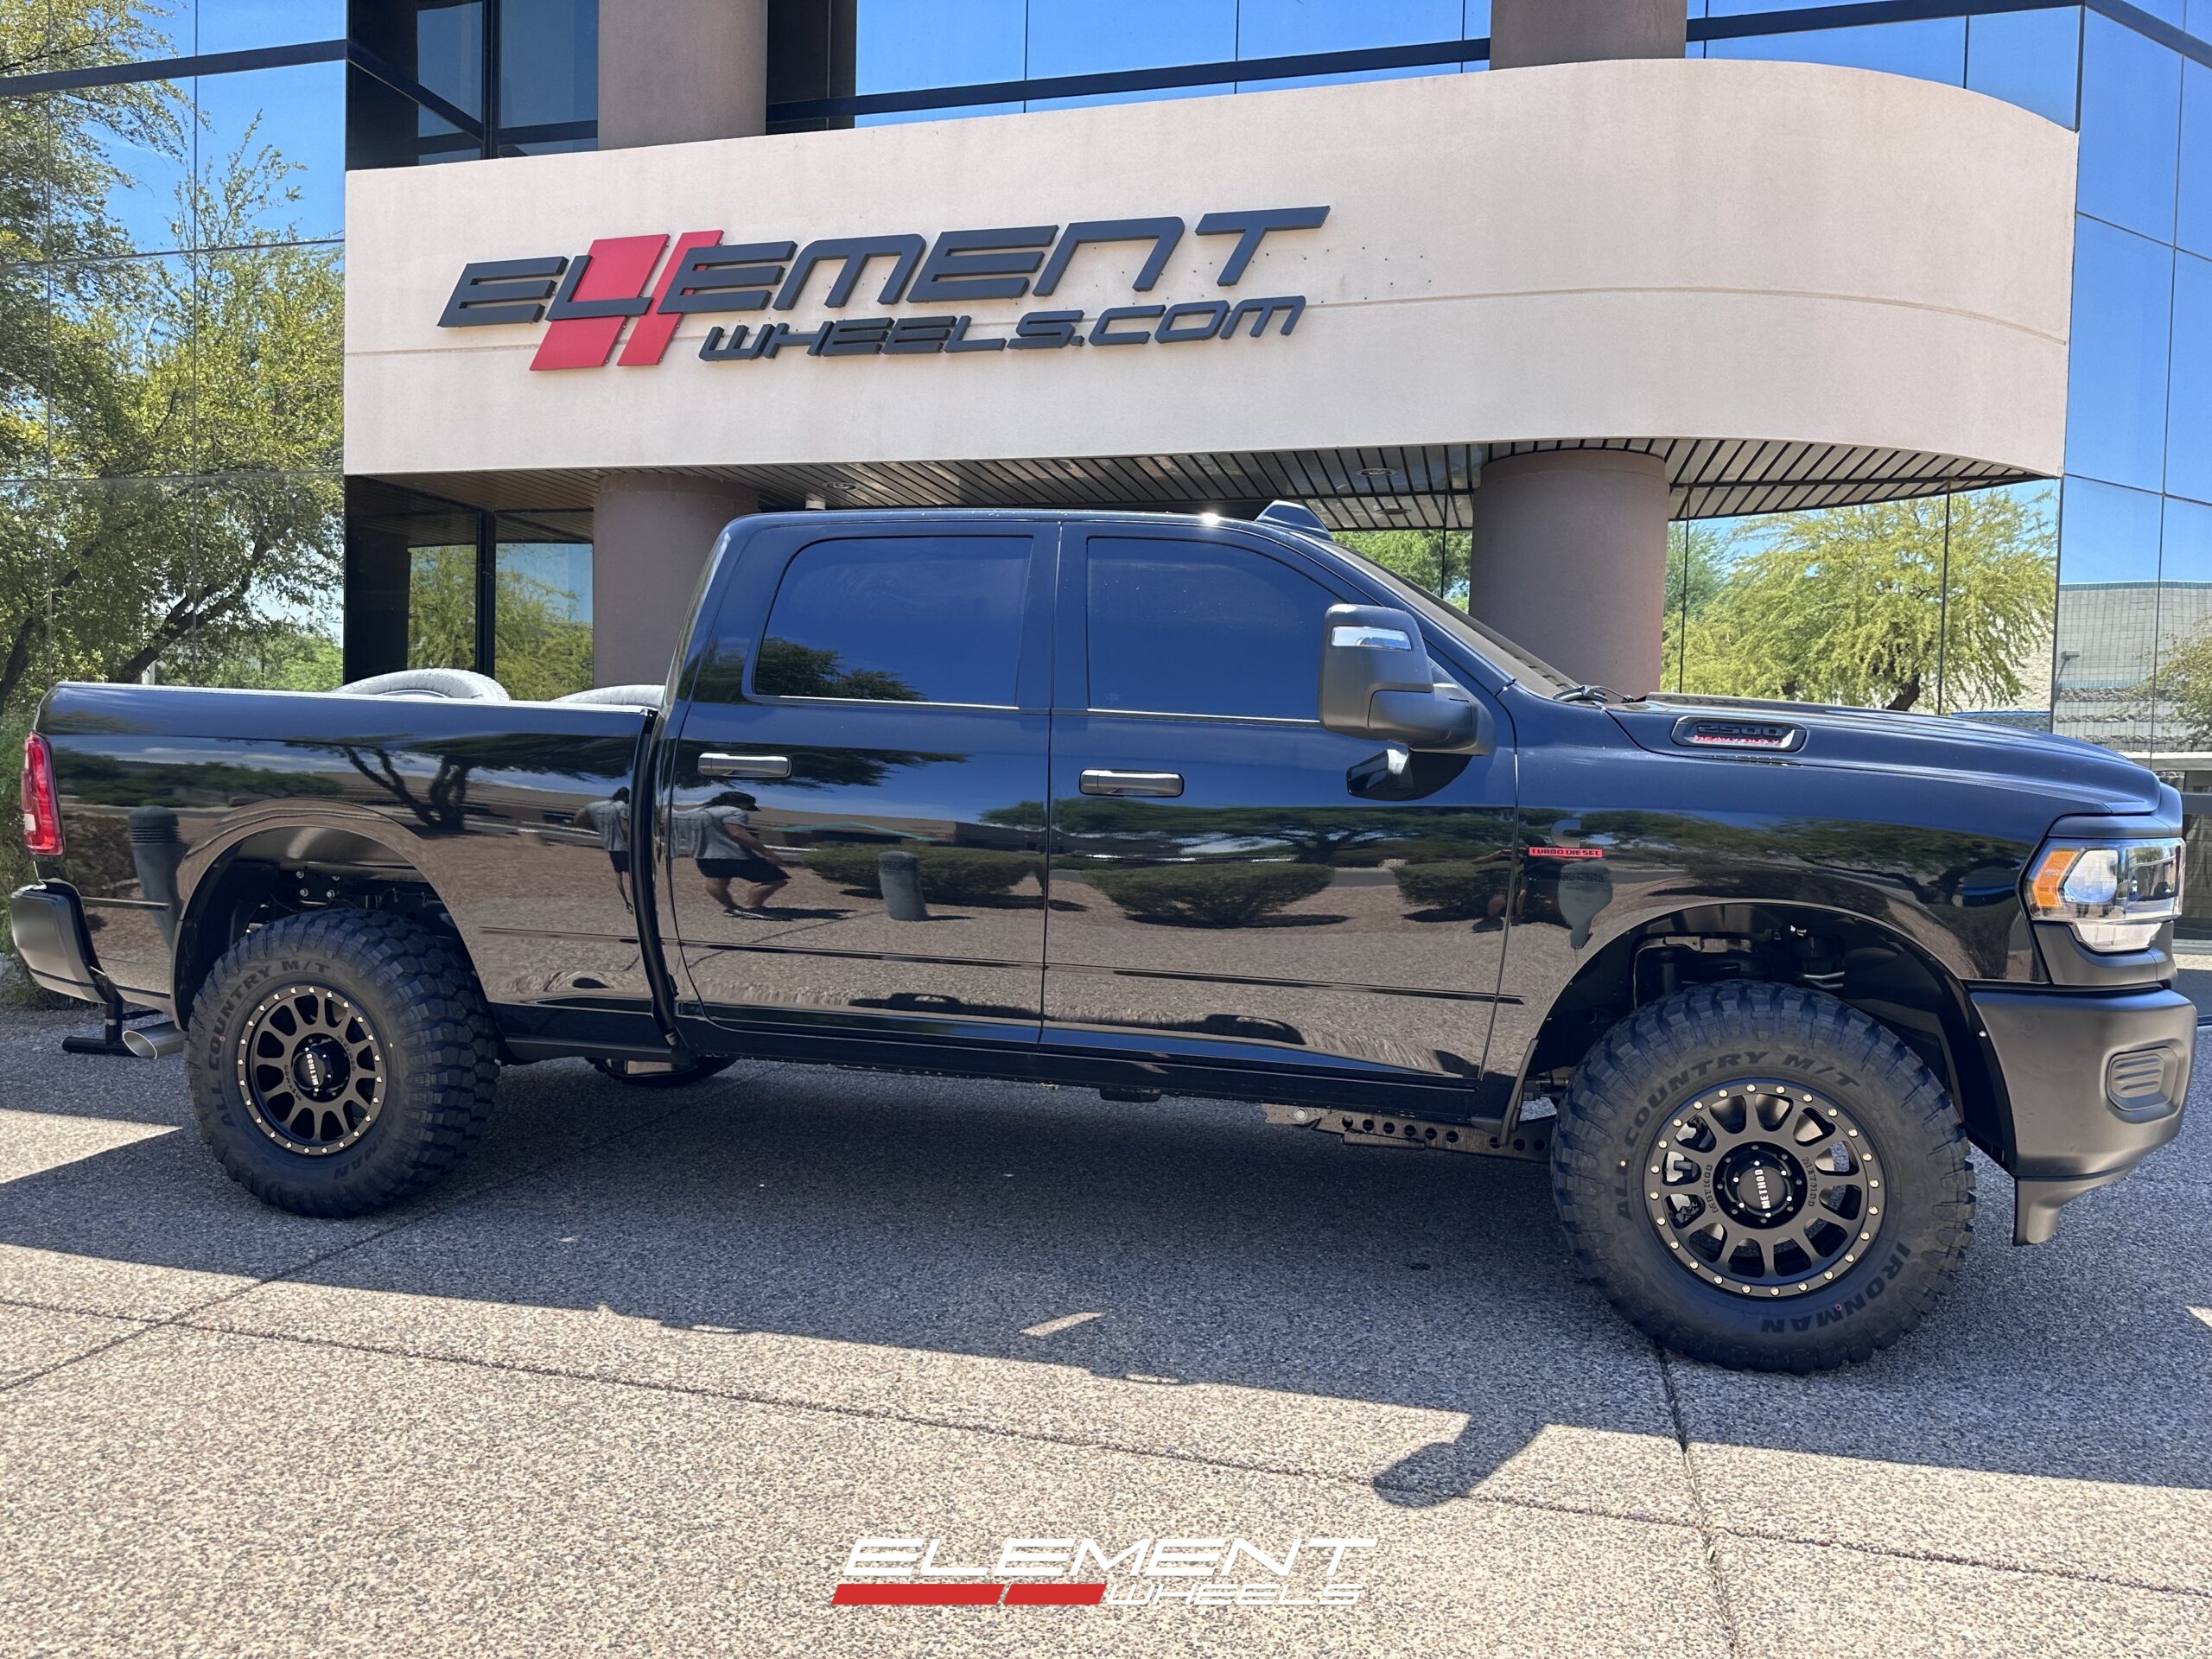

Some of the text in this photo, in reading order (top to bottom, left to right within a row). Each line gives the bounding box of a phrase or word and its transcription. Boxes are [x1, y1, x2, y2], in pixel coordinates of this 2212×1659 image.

[436, 206, 1331, 328] ELEMENT
[698, 296, 1306, 362] WHEELS.COM
[208, 965, 270, 1071] COUNTRY
[1624, 1052, 1769, 1147] COUNTRY
[1783, 1053, 1860, 1087] M/T
[1754, 1168, 1771, 1210] METHOD
[1760, 1243, 1911, 1333] IRONMAN
